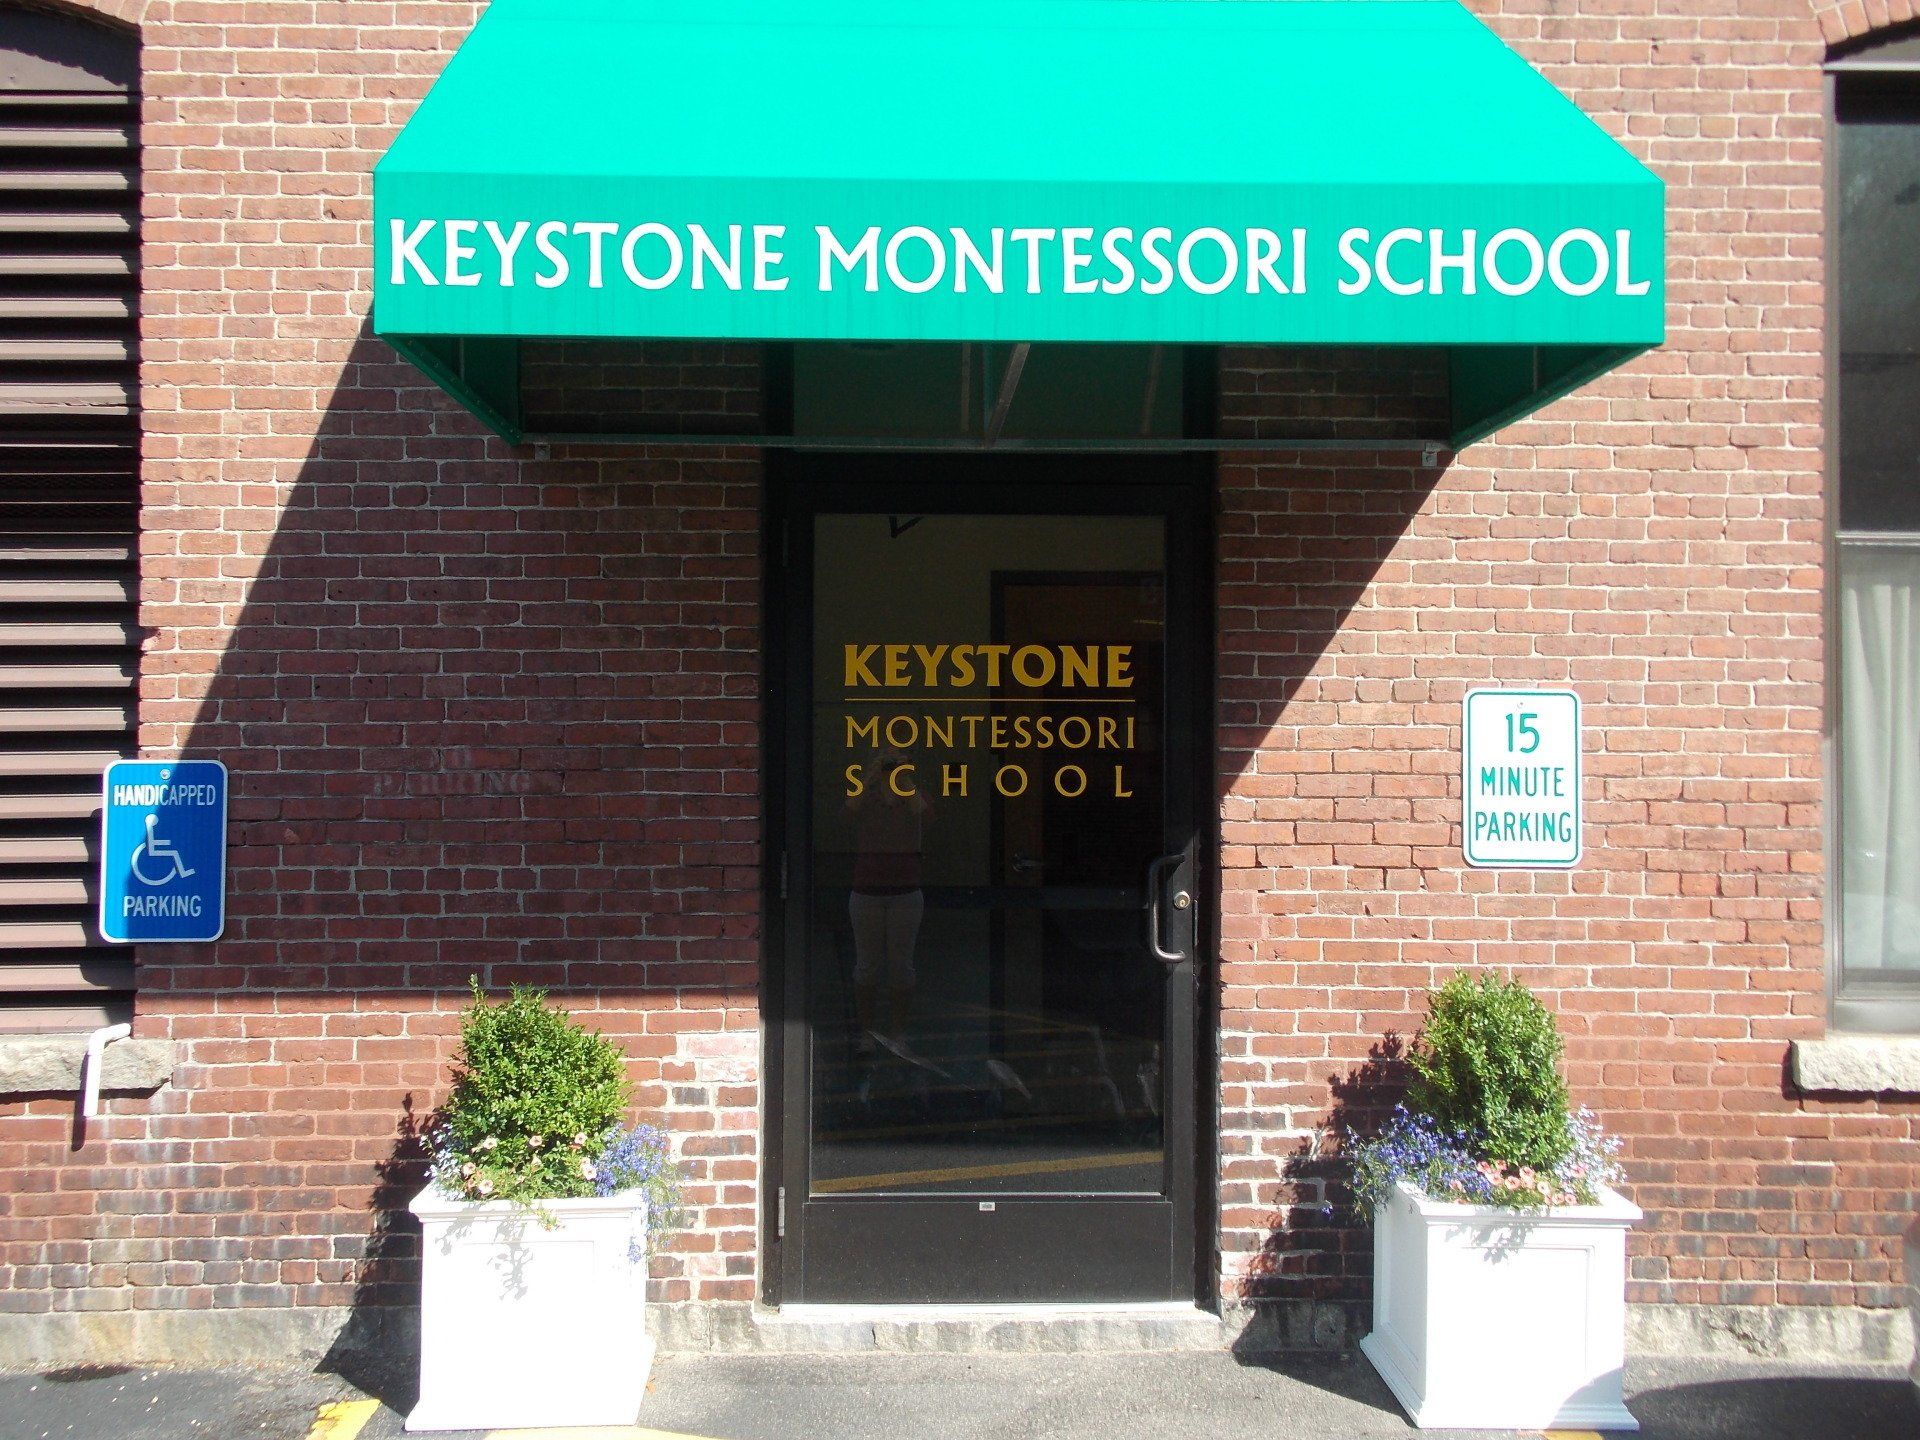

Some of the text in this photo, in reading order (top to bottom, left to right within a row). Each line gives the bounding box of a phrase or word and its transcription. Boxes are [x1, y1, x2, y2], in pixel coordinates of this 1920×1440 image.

[390, 219, 1652, 297] KEYSTONE MONTESSORI SCHOOL
[844, 644, 1135, 688] KEYSTONE
[845, 715, 1135, 749] MONTESSORI
[1506, 713, 1540, 754] 15
[113, 784, 217, 806] HANDICAPPED
[845, 764, 1134, 798] SCHOOL
[1481, 766, 1565, 797] MINUTE
[1475, 811, 1572, 843] PARKING
[123, 894, 202, 917] PARKING
